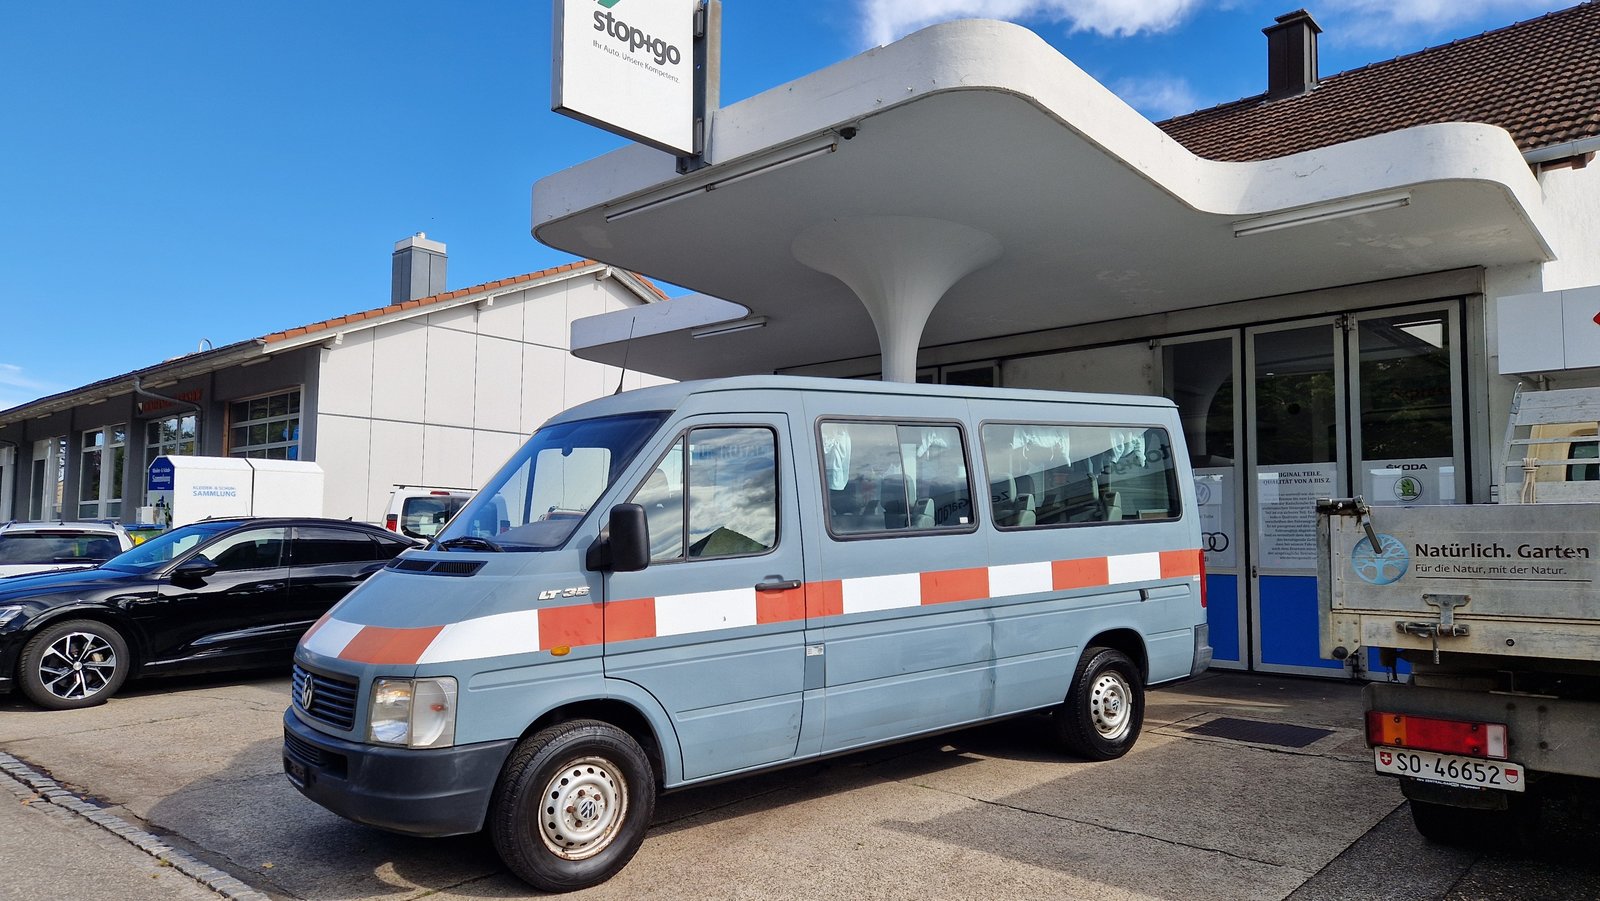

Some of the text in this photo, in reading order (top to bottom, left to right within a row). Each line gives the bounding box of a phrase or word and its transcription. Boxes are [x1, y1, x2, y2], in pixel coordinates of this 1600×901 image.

[593, 10, 681, 65] stop+go
[593, 39, 680, 84] Ihr Auto. Unsere Kompetenz.
[1415, 543, 1590, 559] Natürlich. Garten
[1415, 564, 1567, 575] Für die Natur, mit der Natur.
[538, 590, 561, 600] LT
